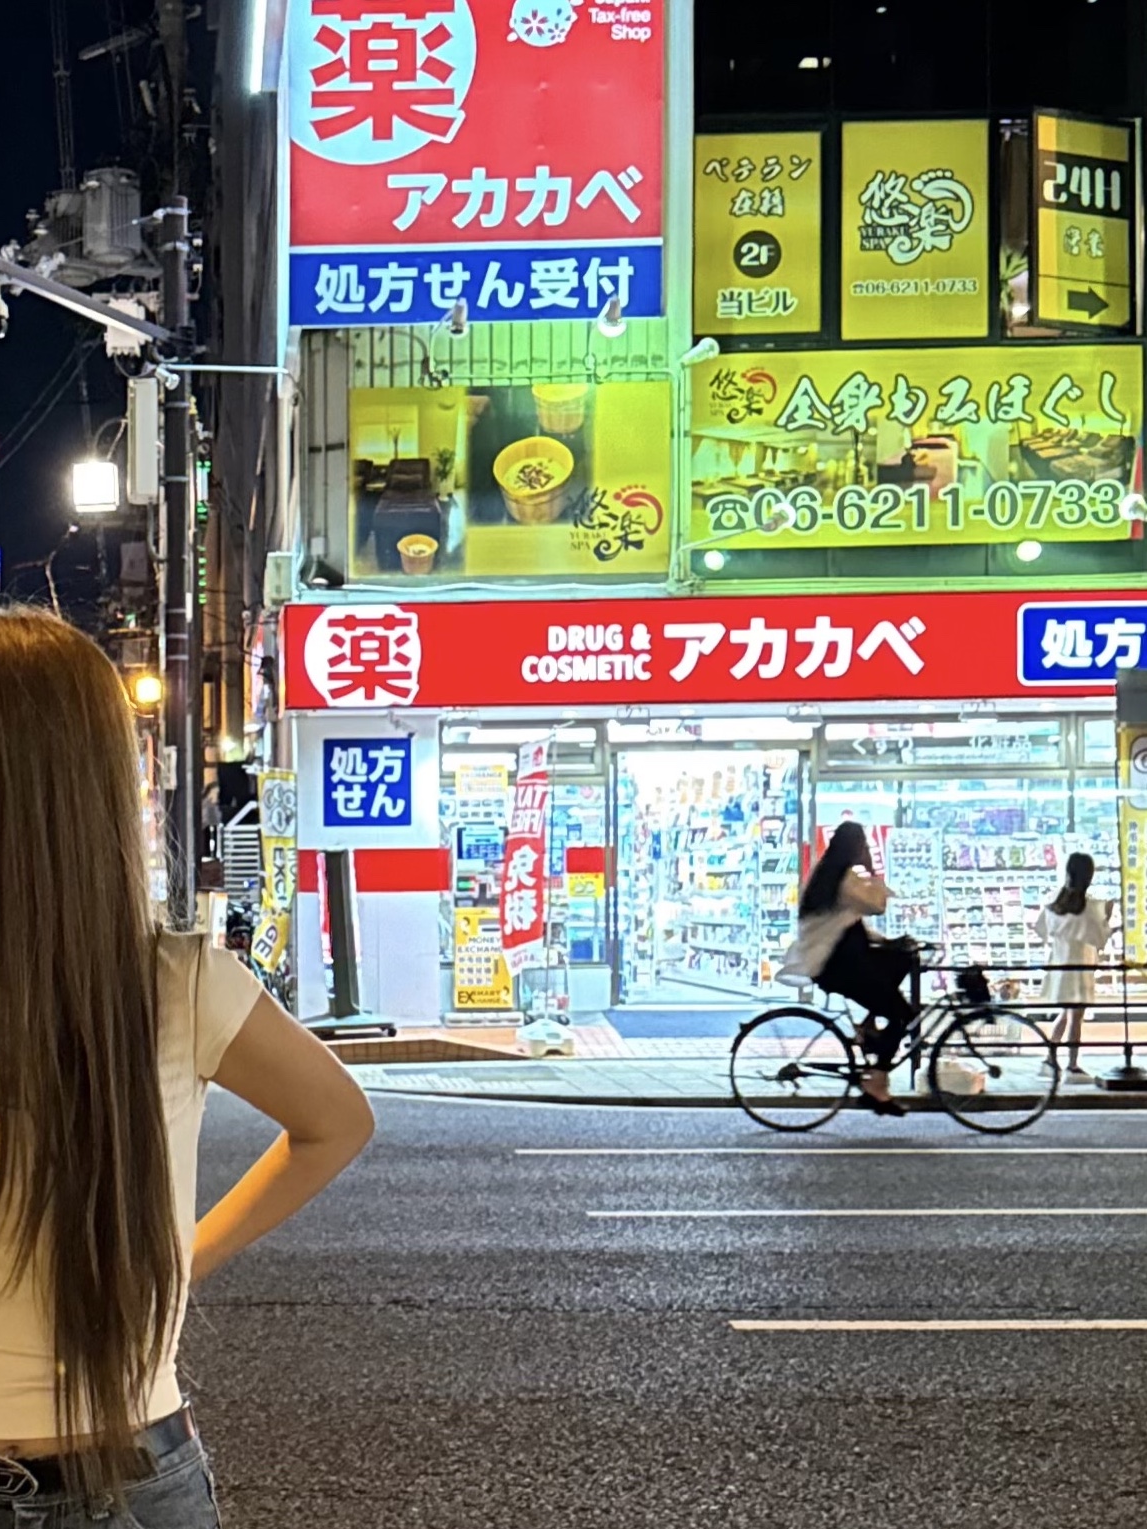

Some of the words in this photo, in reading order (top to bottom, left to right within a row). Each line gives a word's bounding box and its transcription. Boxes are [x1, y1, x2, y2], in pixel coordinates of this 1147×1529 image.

[588, 7, 652, 24] Tax-free
[610, 24, 652, 43] Shop
[310, 0, 457, 142] 薬
[387, 165, 644, 232] アカカベ
[1043, 160, 1121, 212] 24H
[739, 241, 776, 266] 2F
[862, 239, 885, 250] SPA
[314, 256, 635, 316] 処方せん受付
[718, 289, 796, 318] 当ビル
[865, 279, 978, 295] 06-6211-0733
[775, 370, 1127, 434] 全身もみほぐし
[753, 478, 1124, 534] 06-6211-0733
[571, 541, 591, 550] SPA
[548, 626, 624, 653] DRUG
[630, 624, 653, 652] &
[663, 616, 927, 683] アカカベ
[1040, 618, 1146, 669] 処方
[328, 614, 412, 701] 薬
[521, 655, 653, 684] COSMETIC
[329, 746, 406, 783] 処方
[331, 785, 406, 819] せん
